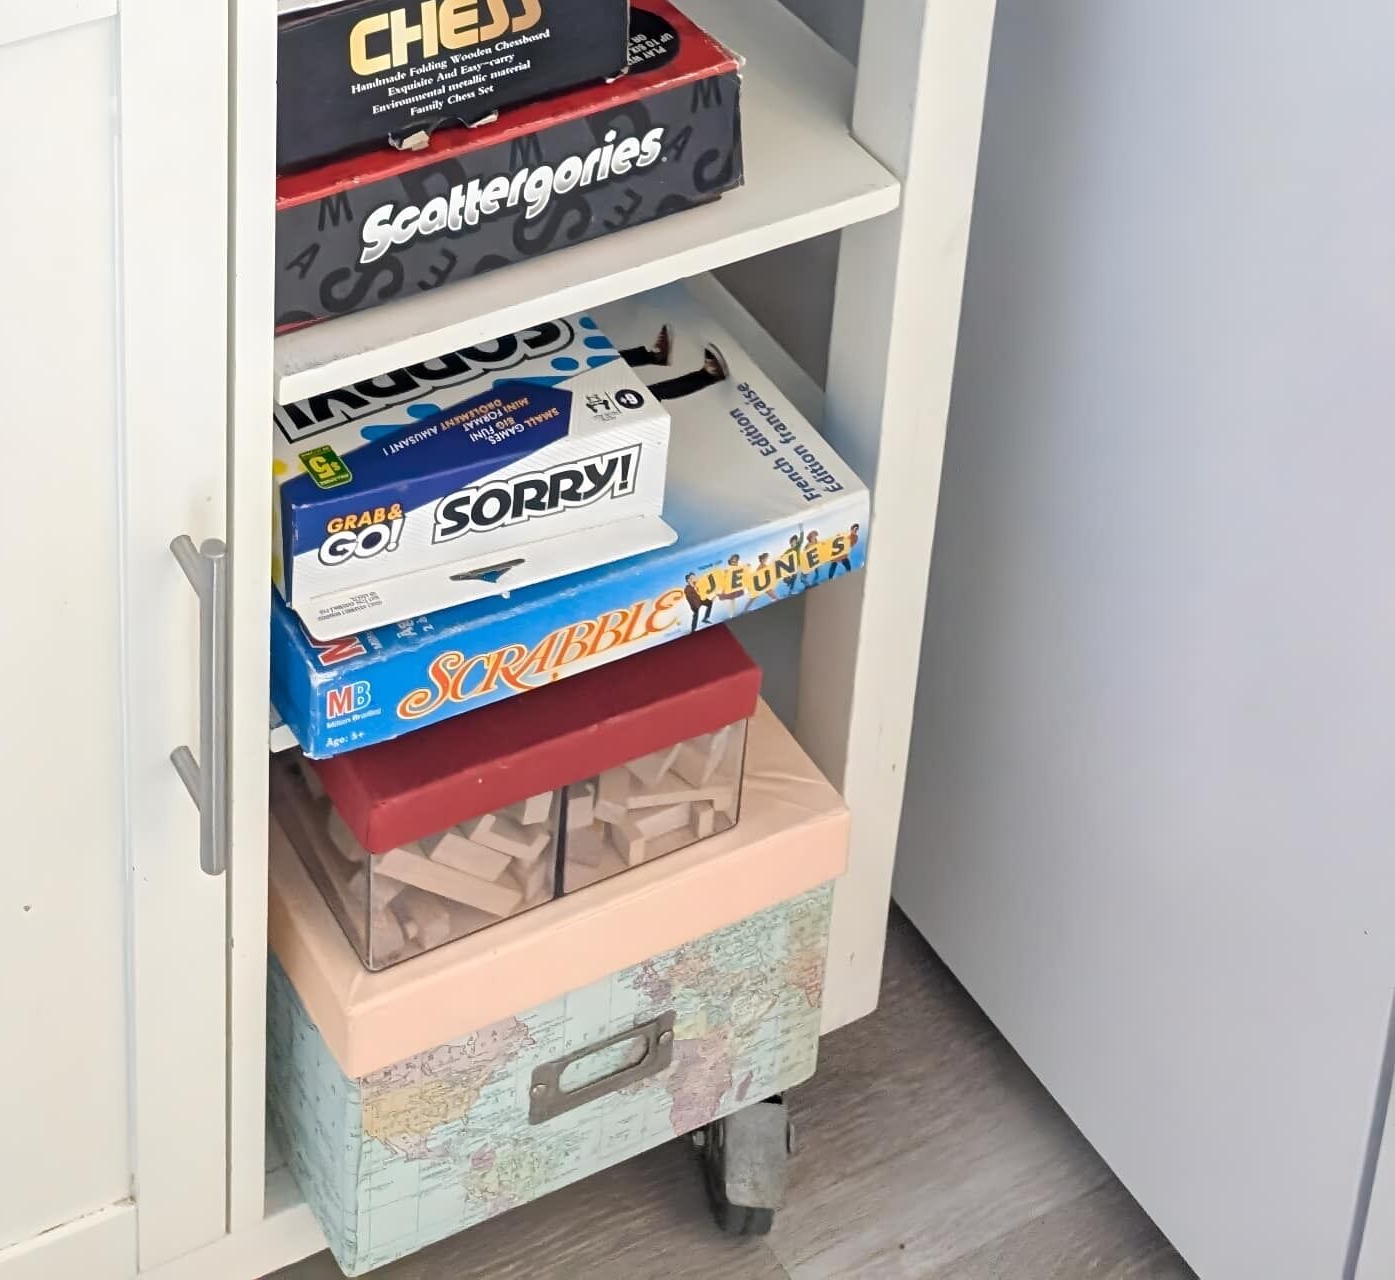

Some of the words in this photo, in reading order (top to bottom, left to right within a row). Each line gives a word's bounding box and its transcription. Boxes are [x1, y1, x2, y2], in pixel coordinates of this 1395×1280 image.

[351, 70, 407, 95] Handmade
[409, 59, 448, 77] Folding
[450, 47, 492, 64] Wooden
[494, 28, 551, 52] Chessboard
[388, 77, 434, 97] Exquisite
[436, 68, 458, 82] And
[372, 85, 446, 115] Environmental
[448, 73, 487, 92] metallic
[490, 60, 531, 79] material
[410, 100, 444, 117] Family
[447, 91, 476, 105] Chess
[477, 84, 495, 96] Set
[360, 127, 662, 264] Scattergories
[463, 410, 504, 431] FORMAT
[504, 397, 530, 413] MINI
[524, 407, 560, 427] SMALL
[737, 382, 797, 444] française
[390, 425, 438, 454] AMUSANT
[730, 408, 778, 457] Edition
[773, 457, 822, 501] French
[794, 445, 844, 493] Édition
[437, 451, 635, 540] SORRY!
[318, 517, 405, 566] GO!
[705, 536, 846, 596] JEUNES
[397, 588, 684, 720] SCRABBLE
[327, 680, 371, 719] MB
[326, 736, 348, 748] Age:
